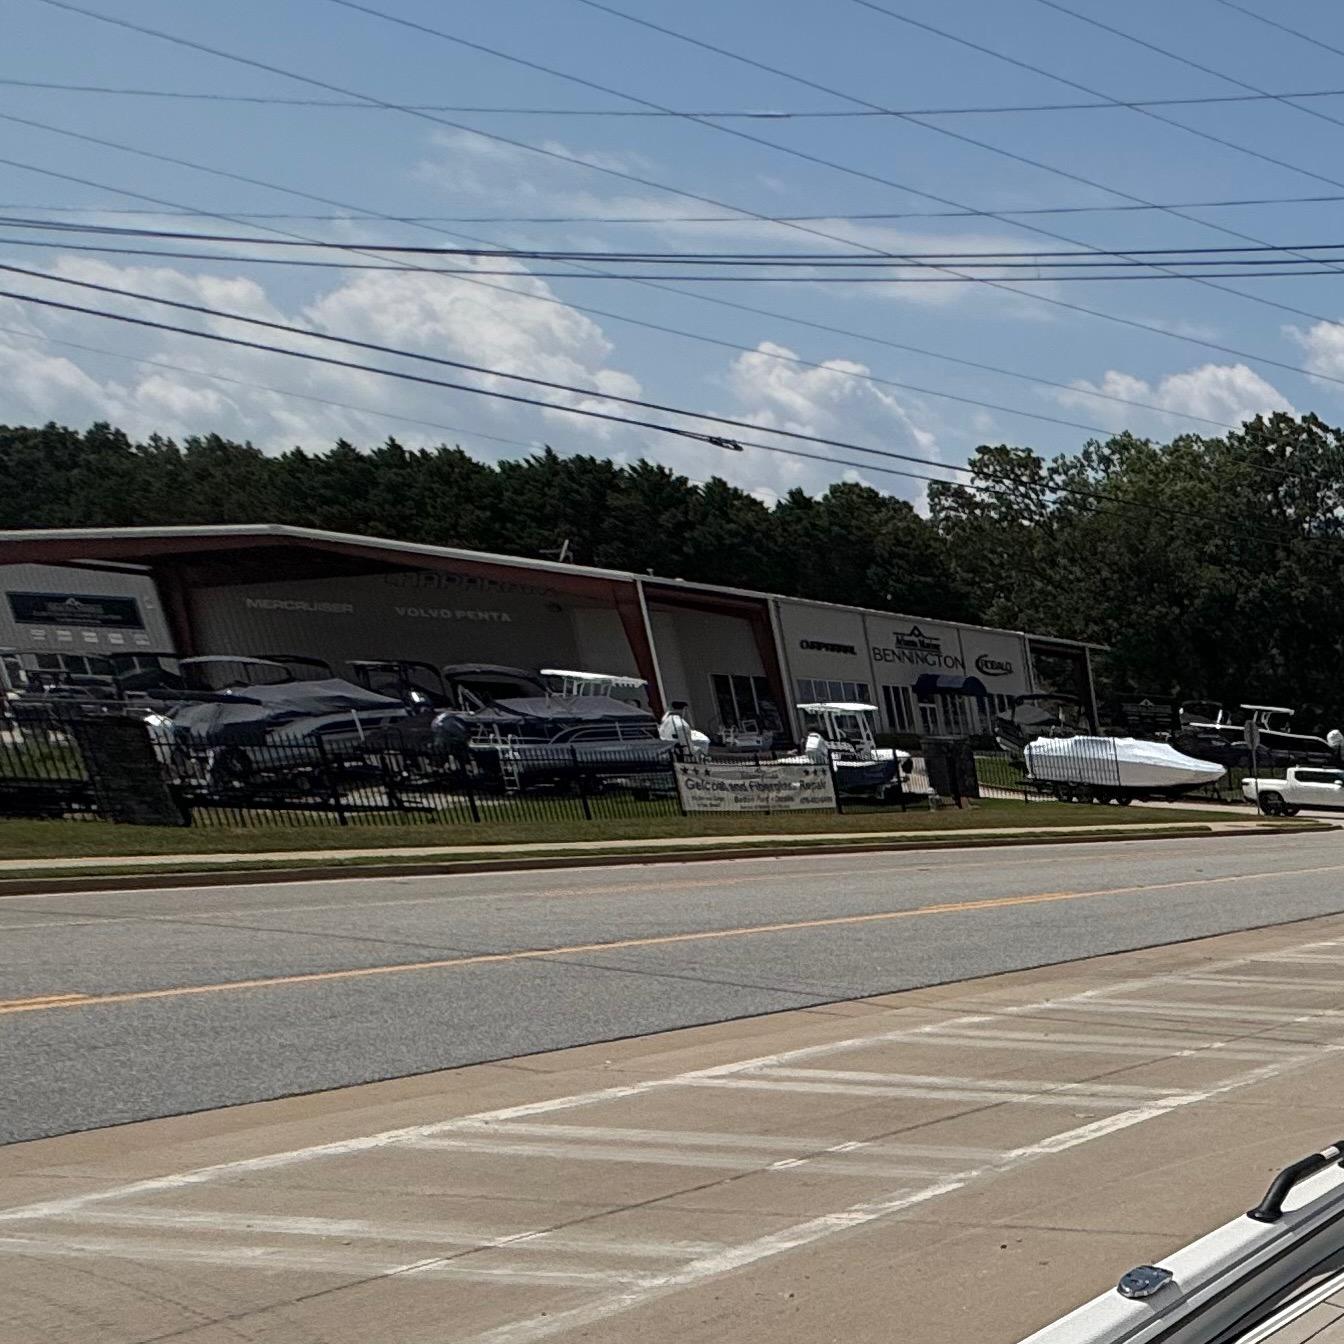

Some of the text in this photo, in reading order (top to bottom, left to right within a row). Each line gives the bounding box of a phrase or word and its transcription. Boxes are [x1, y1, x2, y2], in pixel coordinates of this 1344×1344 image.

[395, 606, 512, 623] VOLVO PENTA
[872, 647, 966, 672] BENNINGTON
